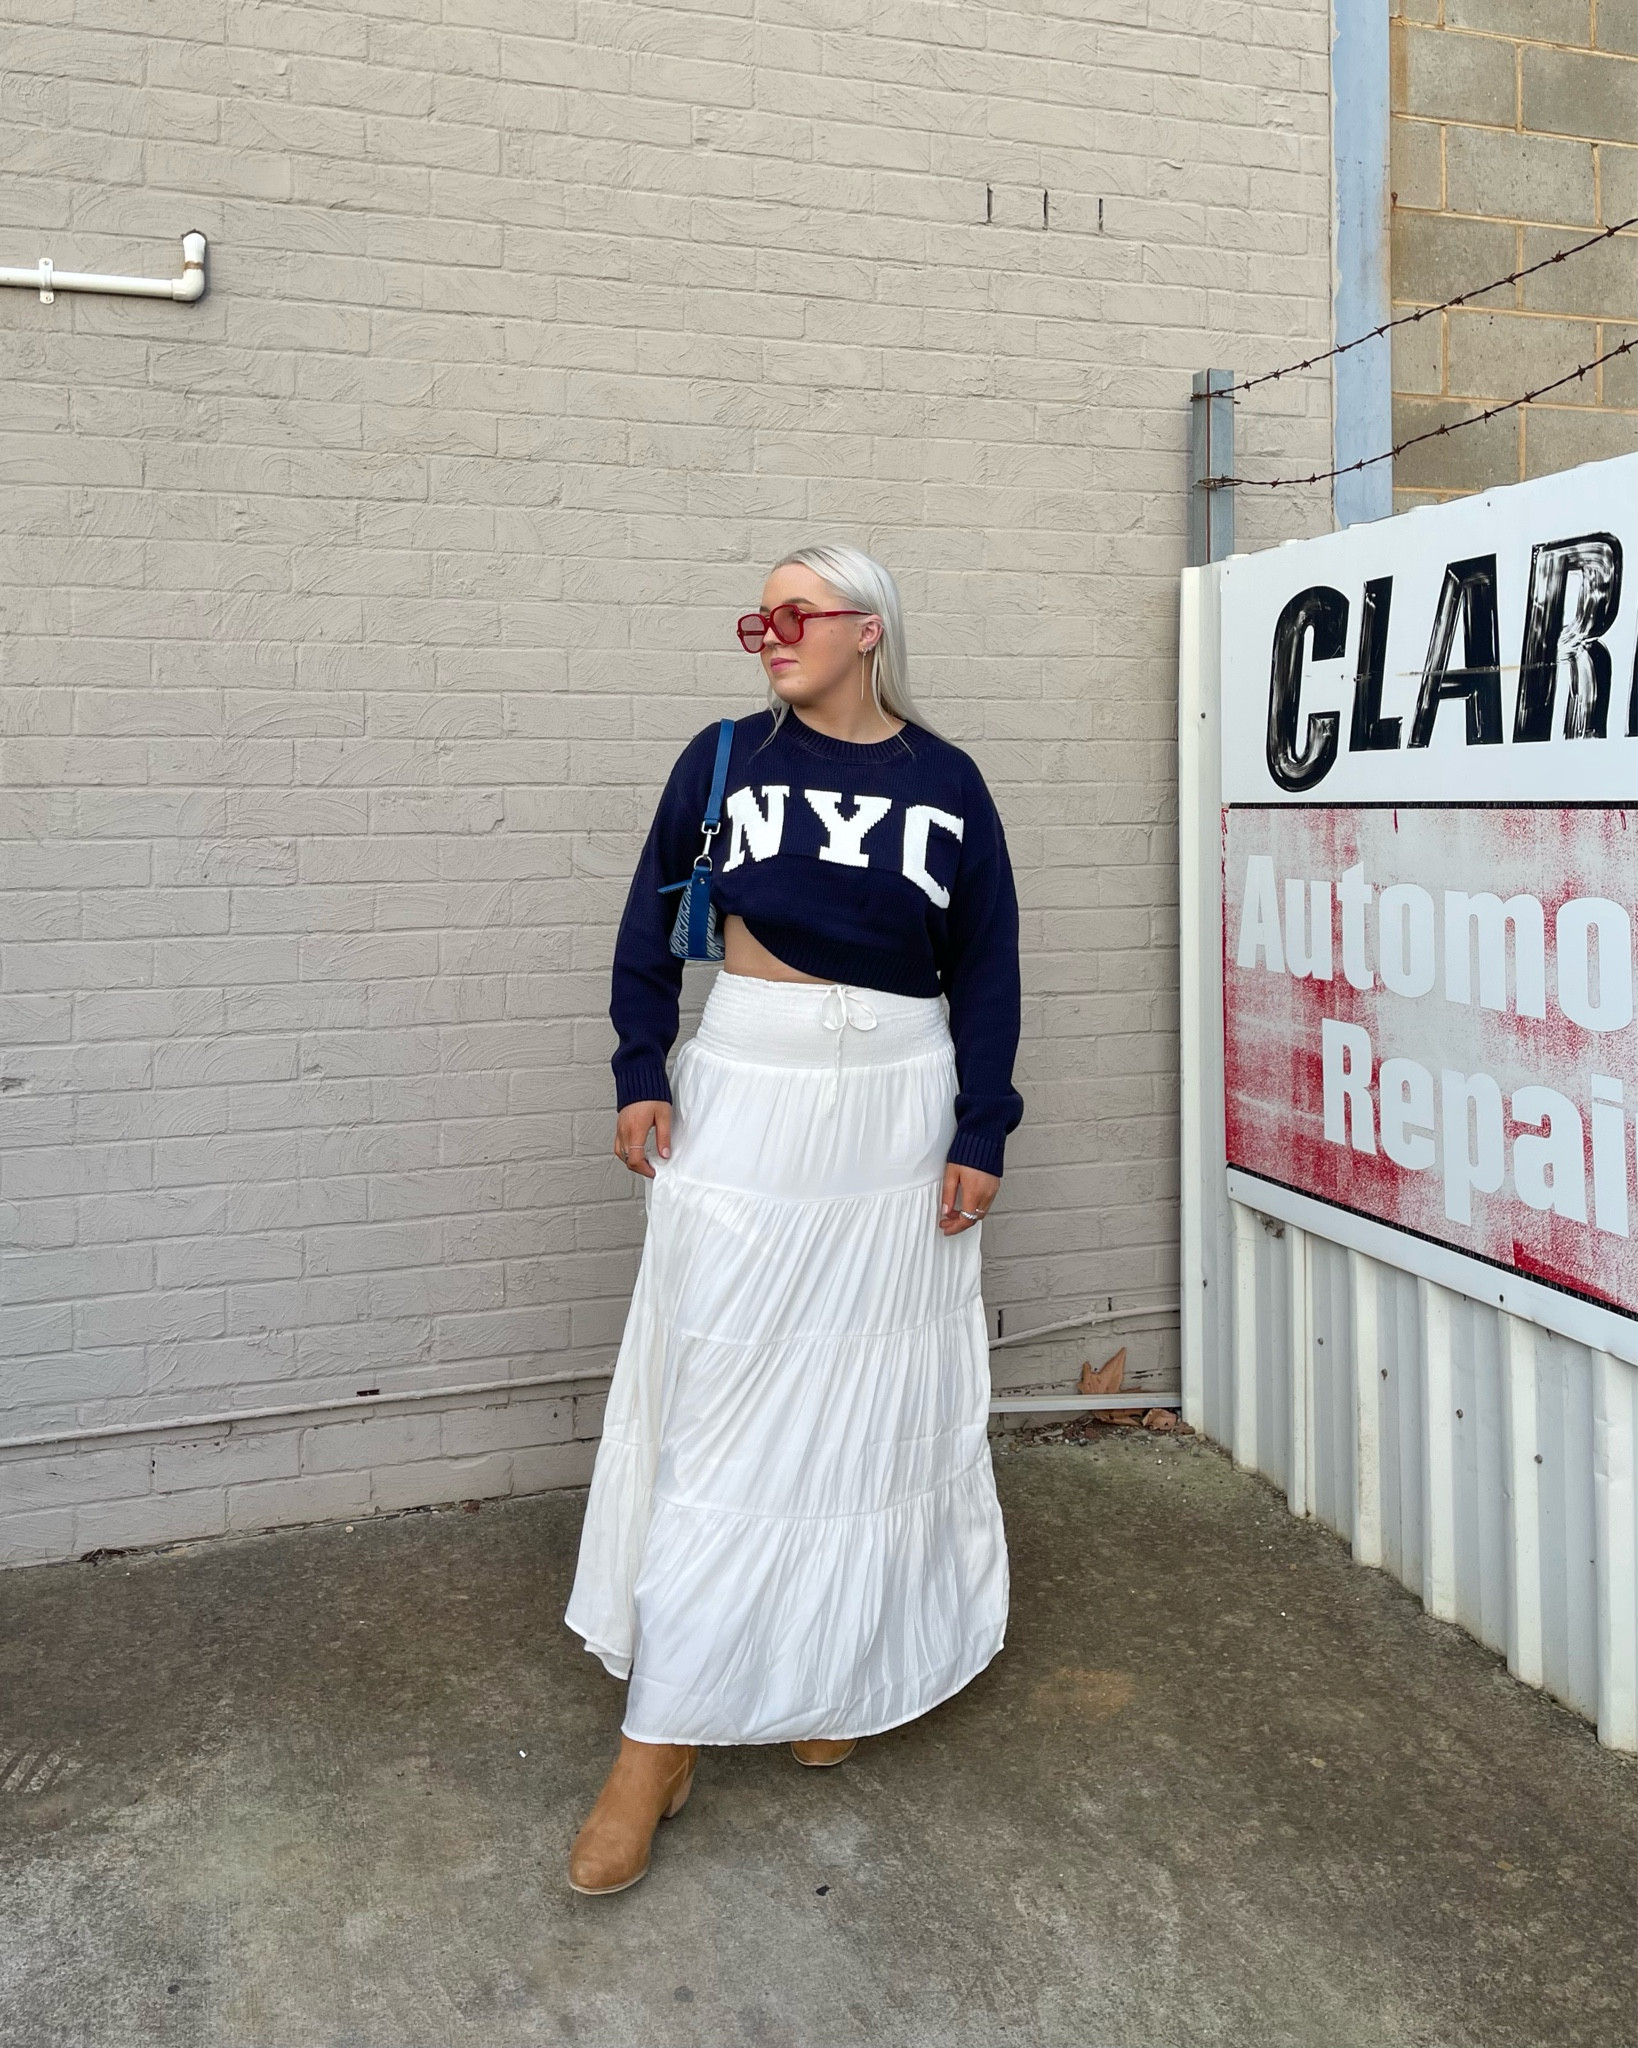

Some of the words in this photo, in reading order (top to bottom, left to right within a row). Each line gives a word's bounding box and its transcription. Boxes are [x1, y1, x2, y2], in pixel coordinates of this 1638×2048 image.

[1266, 532, 1638, 792] CLAR
[722, 785, 965, 909] NYC
[1237, 855, 1634, 1033] Automo
[1322, 1019, 1638, 1239] Repai
